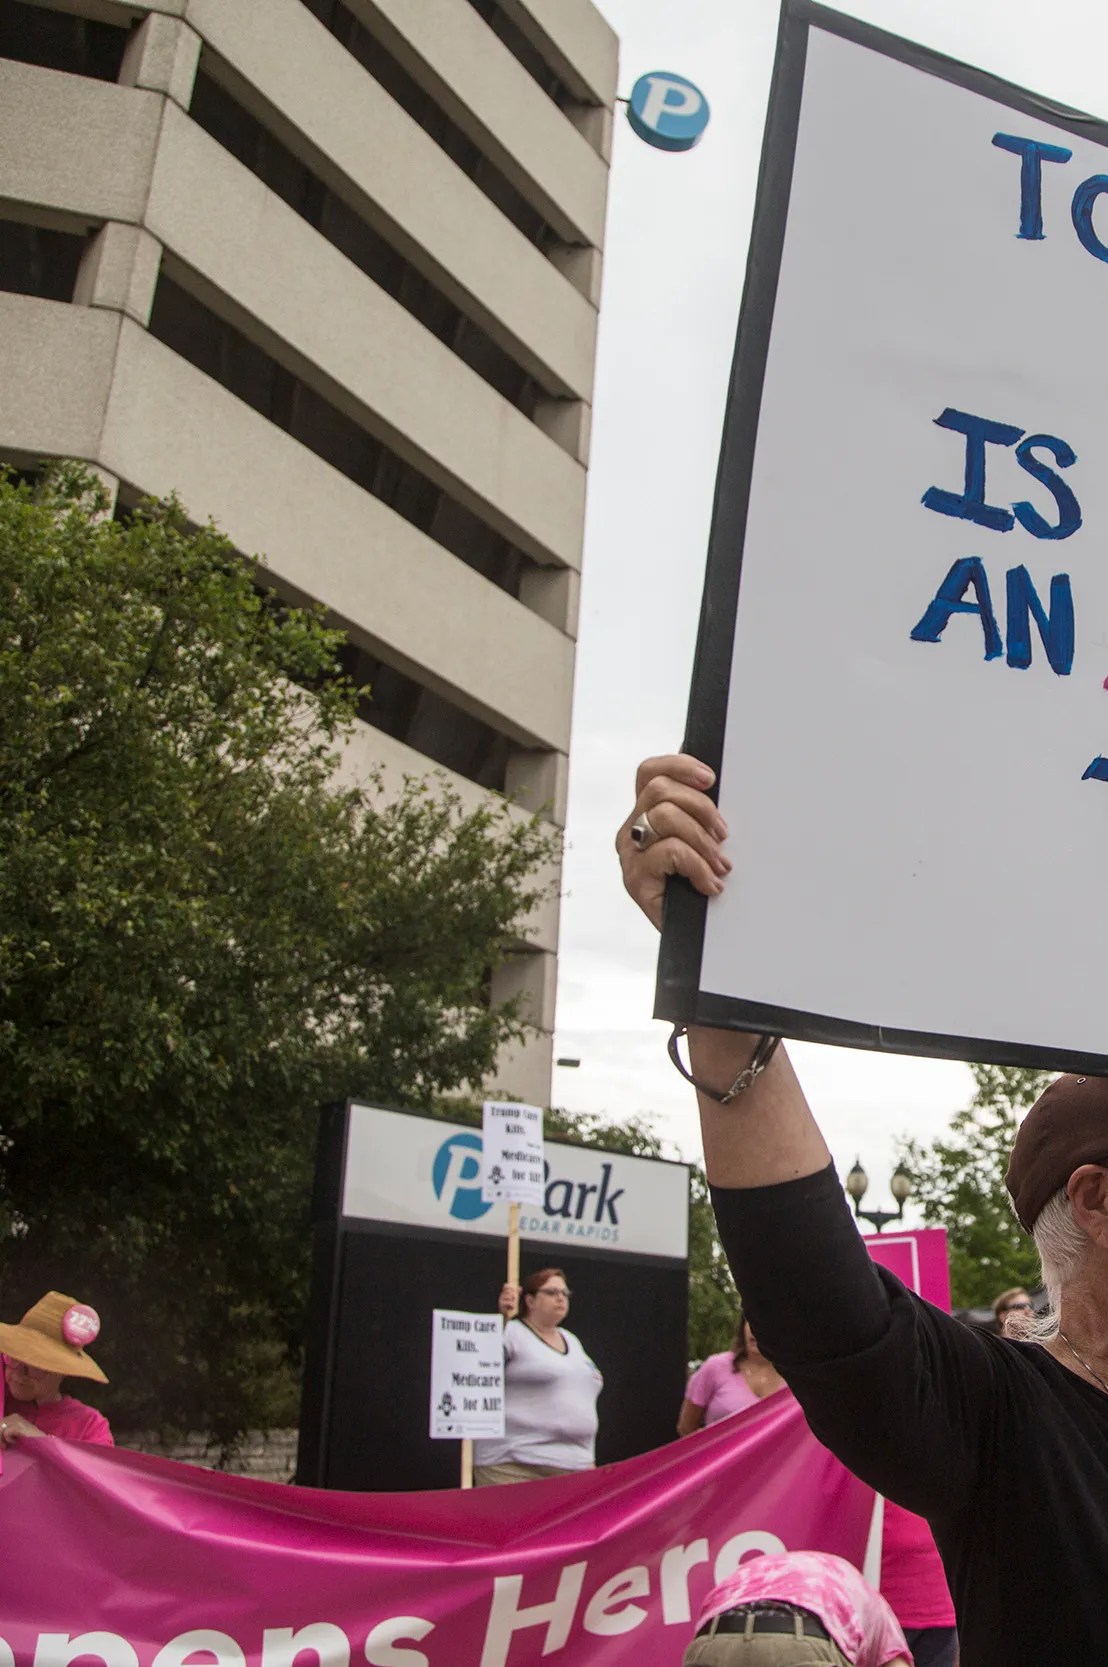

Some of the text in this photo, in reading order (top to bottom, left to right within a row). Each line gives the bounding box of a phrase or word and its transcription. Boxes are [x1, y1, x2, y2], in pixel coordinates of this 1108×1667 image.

[640, 77, 702, 131] P
[921, 407, 1082, 540] IS
[910, 556, 1075, 675] AN
[543, 1158, 625, 1225] ark
[566, 1222, 619, 1242] RAPIDS
[441, 1317, 496, 1333] Trump Care
[452, 1372, 500, 1387] Medicare
[463, 1397, 477, 1411] for
